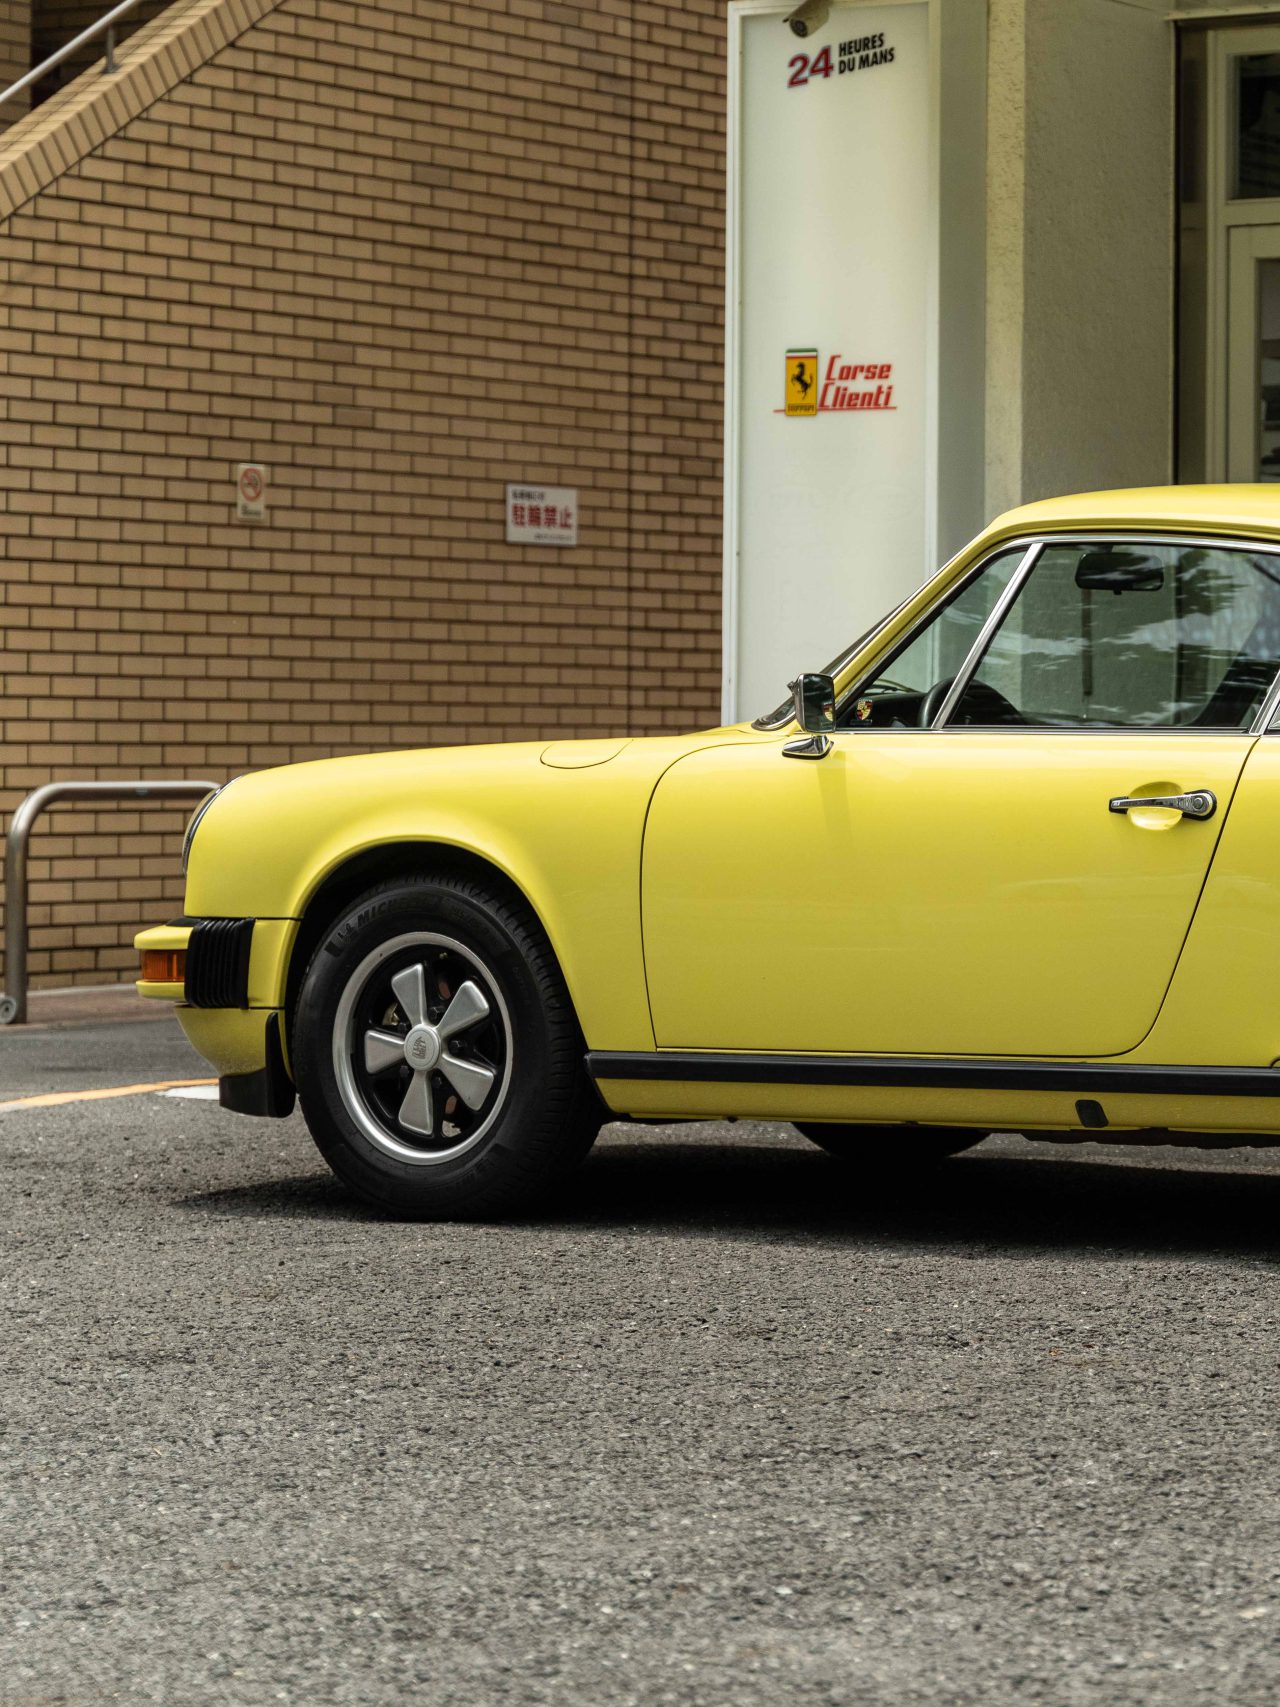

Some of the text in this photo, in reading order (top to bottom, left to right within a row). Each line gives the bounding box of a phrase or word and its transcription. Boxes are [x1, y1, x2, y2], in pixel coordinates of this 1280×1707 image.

[839, 33, 884, 57] HEURES
[787, 45, 834, 88] 24
[838, 47, 895, 74] DU MANS
[825, 354, 892, 381] Corse
[818, 381, 893, 408] Clienti
[512, 503, 573, 530] 駐輪禁止
